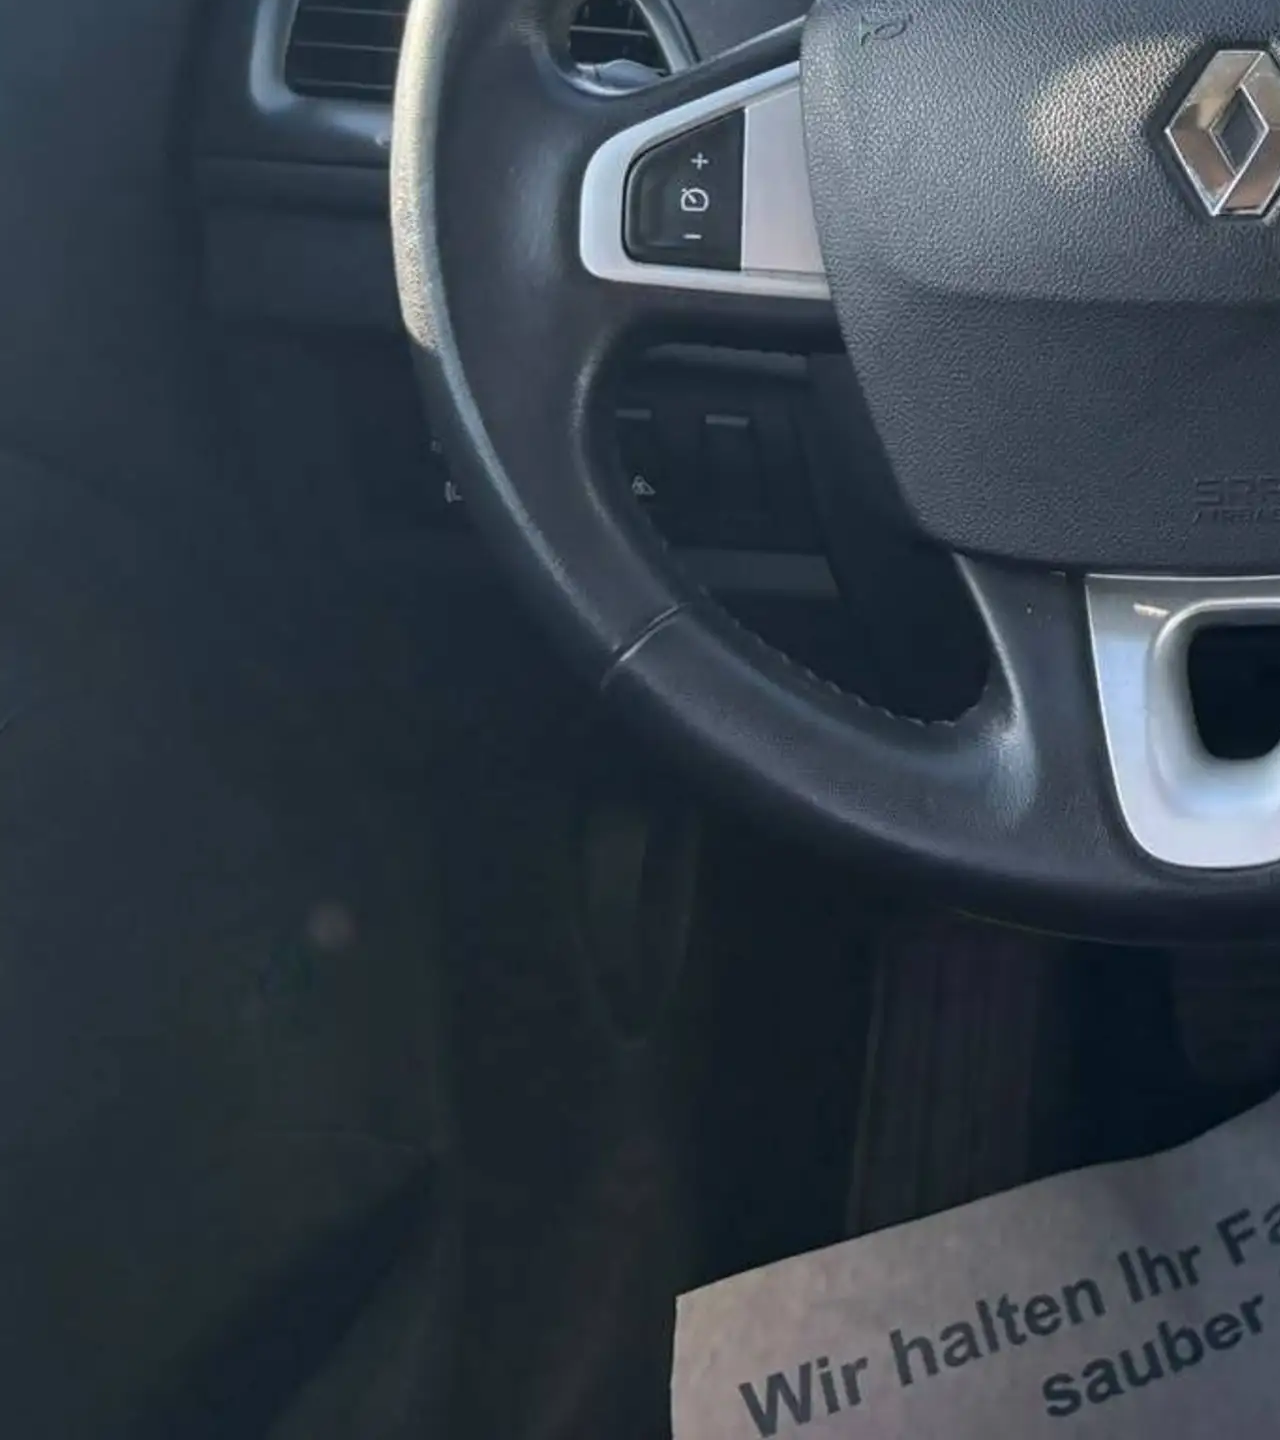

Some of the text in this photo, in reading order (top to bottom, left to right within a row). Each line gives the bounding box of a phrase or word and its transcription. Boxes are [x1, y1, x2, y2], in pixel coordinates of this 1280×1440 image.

[739, 1356, 868, 1438] Wir
[889, 1277, 1106, 1387] halten
[1117, 1244, 1202, 1304] Ihr
[1042, 1293, 1264, 1417] sauber
